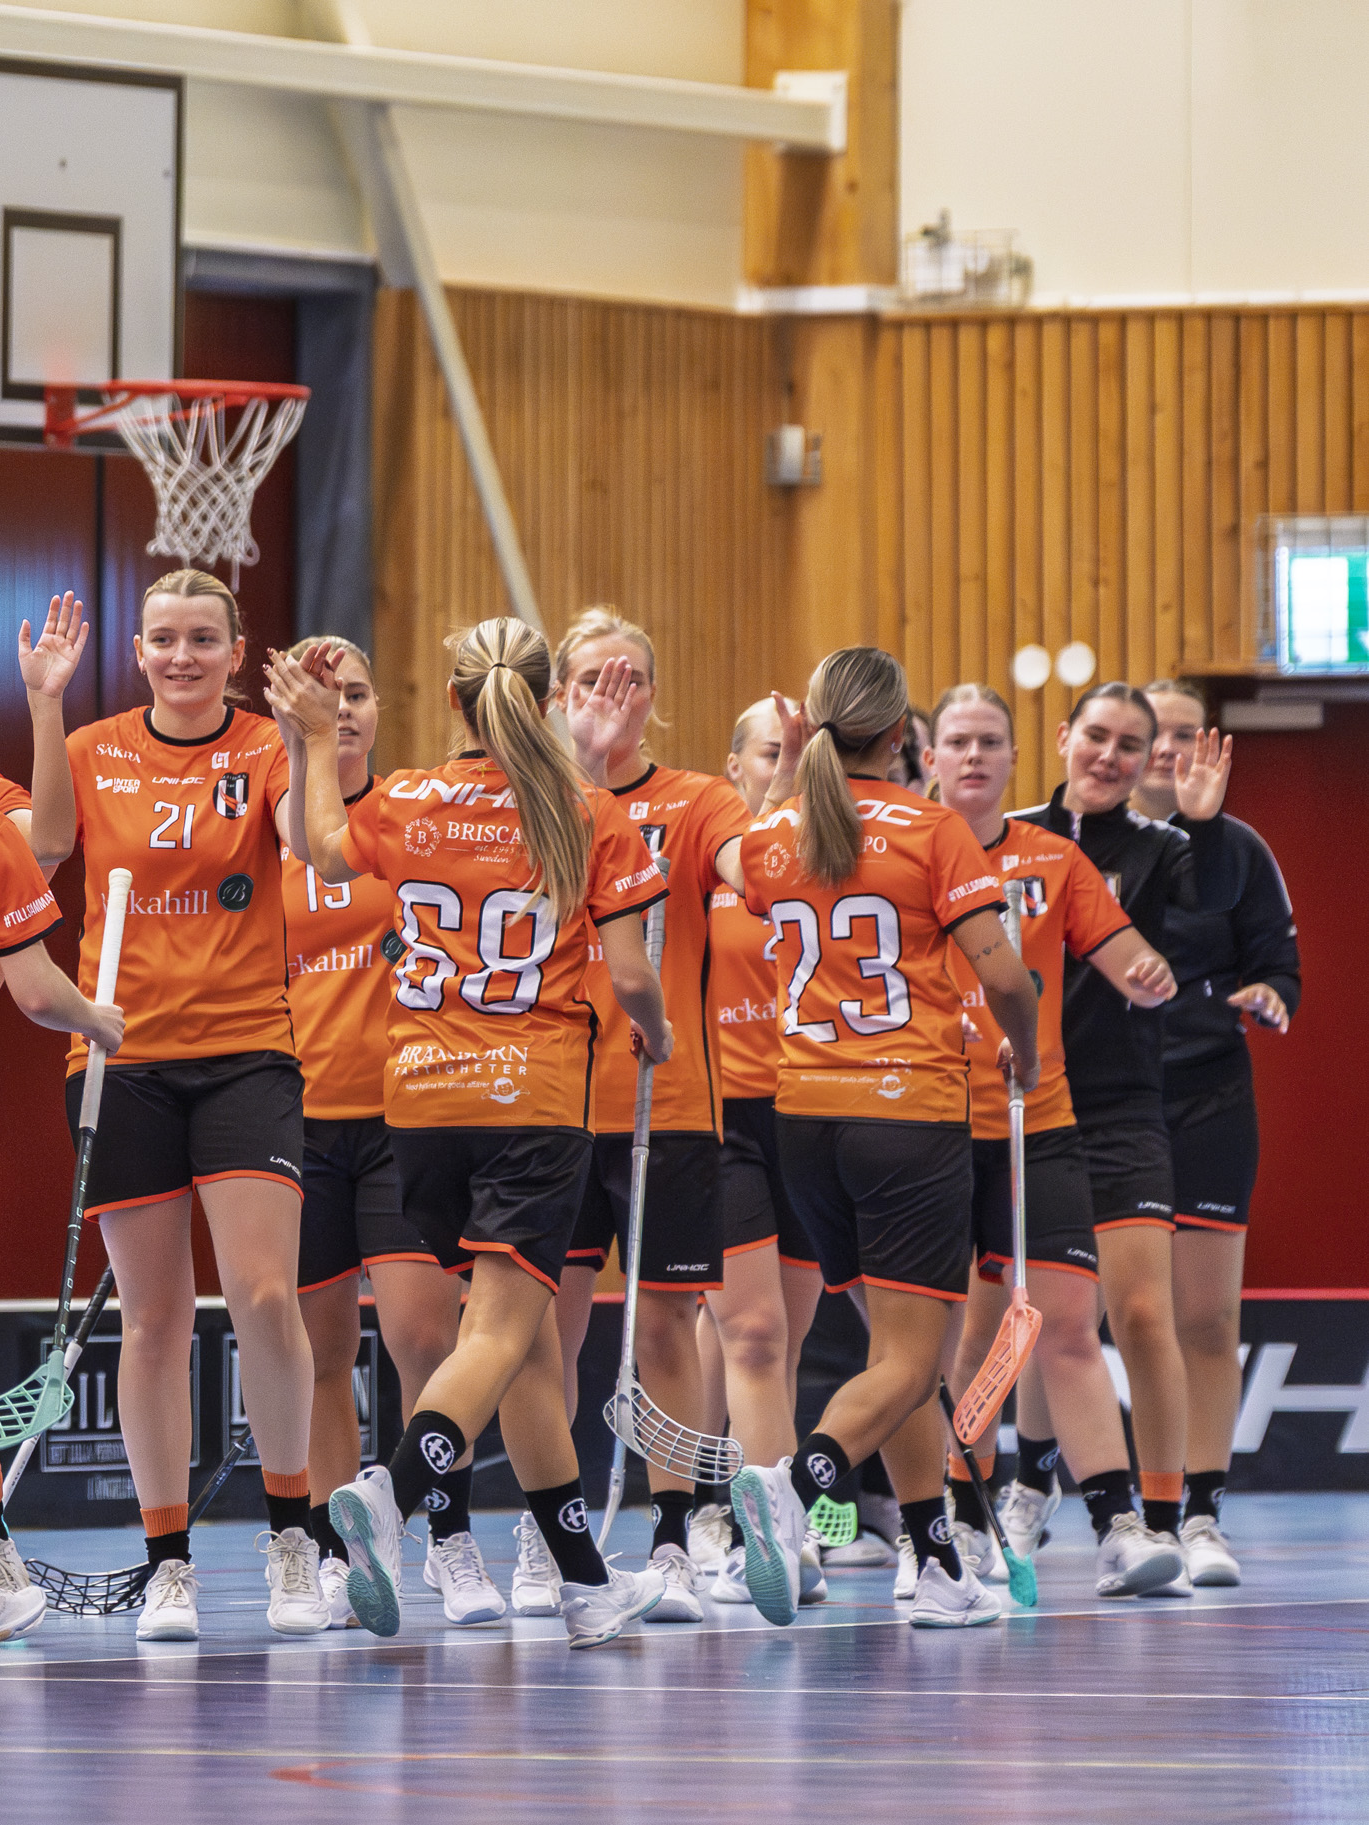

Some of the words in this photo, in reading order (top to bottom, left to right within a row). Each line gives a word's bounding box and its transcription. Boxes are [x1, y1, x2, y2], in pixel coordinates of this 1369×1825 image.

[96, 743, 141, 763] SÄKRA
[113, 777, 141, 788] INTER
[113, 785, 140, 794] SPORT
[152, 776, 206, 785] UNIHOC
[389, 778, 521, 809] UNIH
[149, 801, 196, 849] 21
[446, 821, 521, 844] BRISCA
[101, 889, 209, 915] kahill
[395, 879, 559, 1015] 68
[288, 945, 373, 978] ckahill
[771, 893, 912, 1043] 23
[394, 1063, 527, 1076] FASTIGHETER
